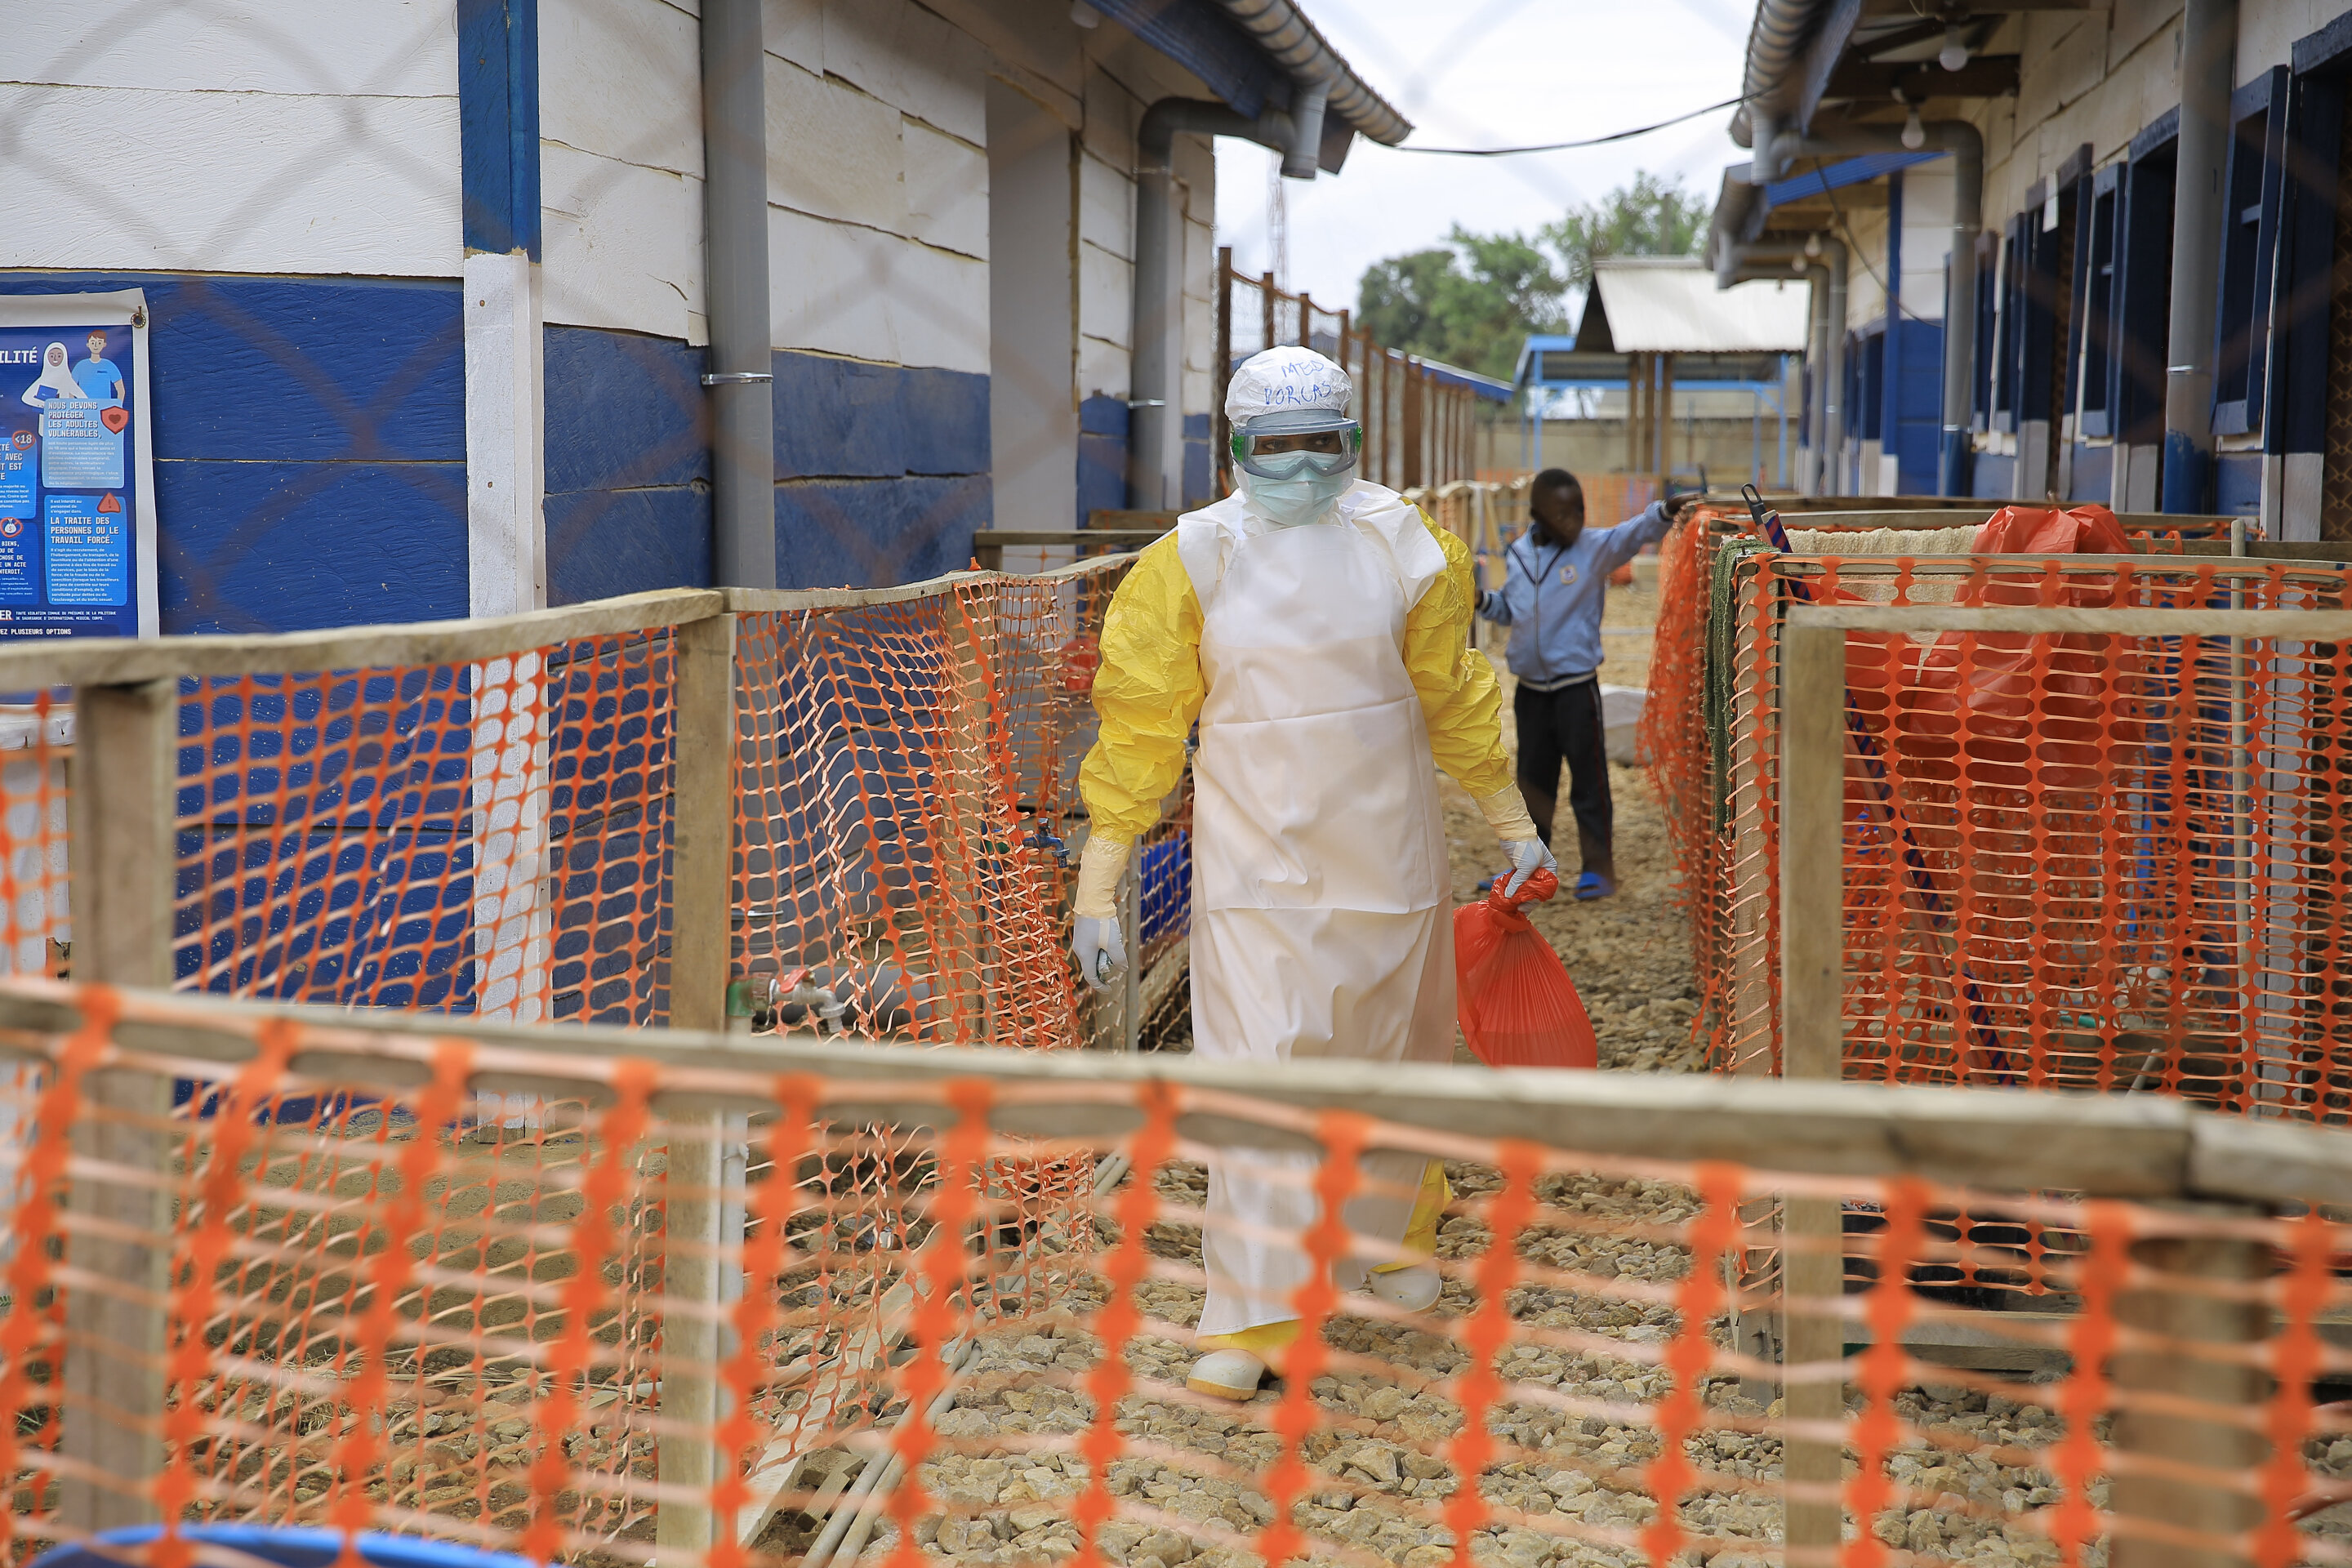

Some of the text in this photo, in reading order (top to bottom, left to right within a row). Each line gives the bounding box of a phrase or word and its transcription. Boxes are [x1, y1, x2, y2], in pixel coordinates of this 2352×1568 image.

[1281, 359, 1325, 378] MED
[48, 410, 84, 419] PROTÉGER
[48, 429, 101, 439] VULNÉRABLES,
[5, 452, 23, 461] AVEC
[51, 526, 119, 535] PERSONNES OU LE
[51, 535, 114, 544] TRAVAIL FORCÉ.
